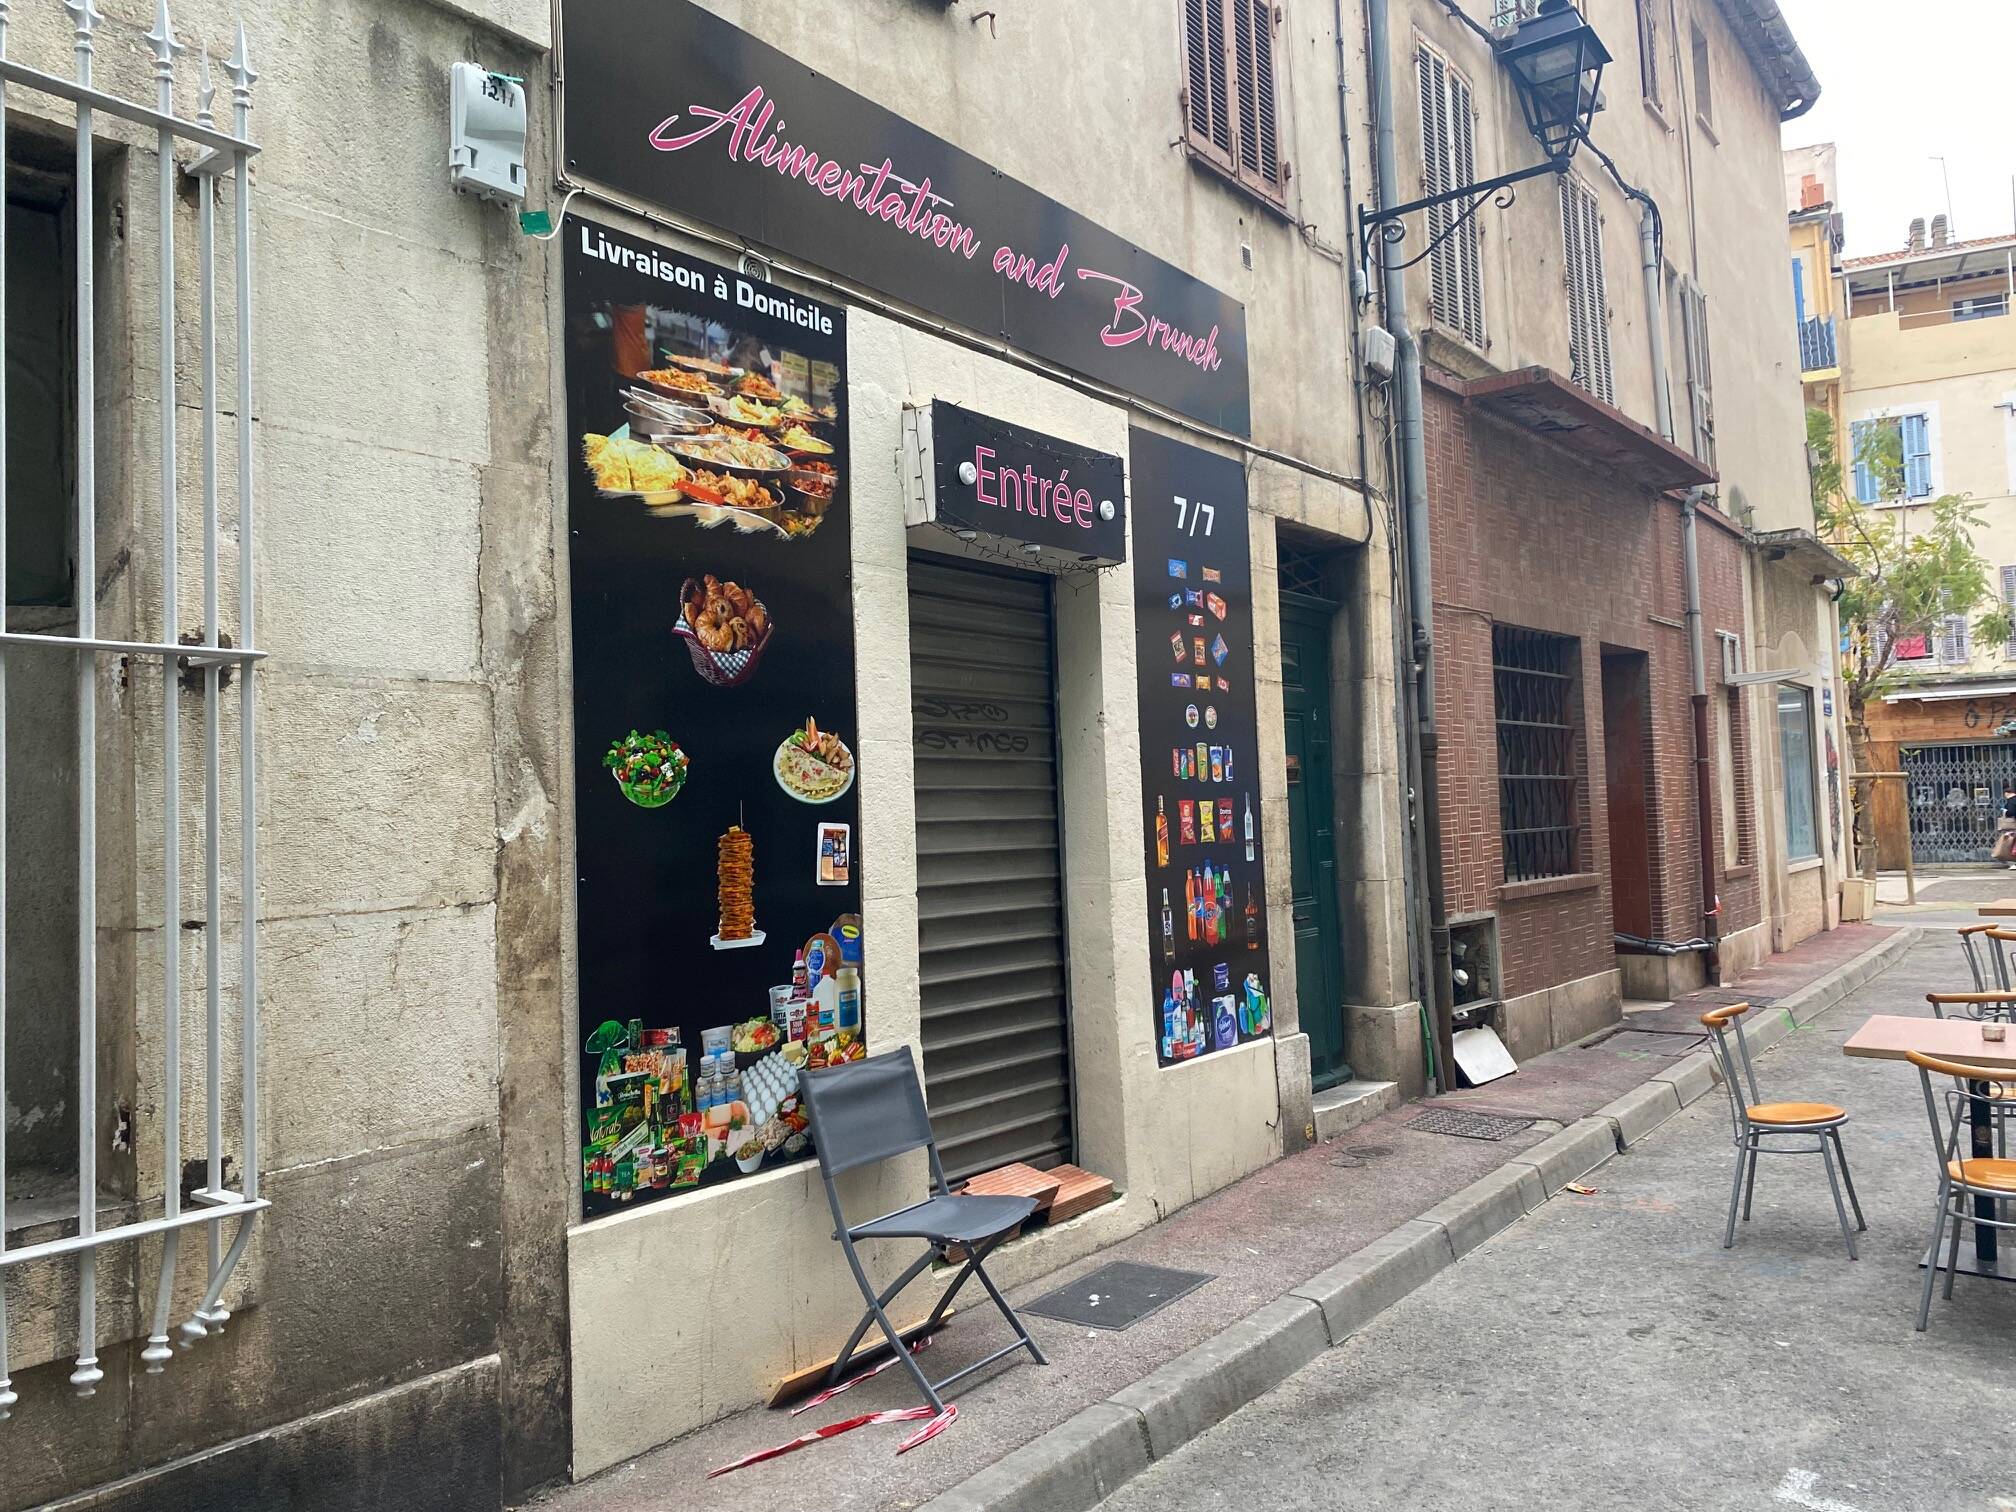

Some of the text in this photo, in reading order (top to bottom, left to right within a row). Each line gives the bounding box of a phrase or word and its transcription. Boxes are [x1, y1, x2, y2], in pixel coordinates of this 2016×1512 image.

[648, 85, 1223, 372] Alimentation and Brunch
[580, 226, 834, 336] Livraison à Domicile
[974, 445, 1094, 528] Entrée
[1173, 495, 1215, 537] 7/7
